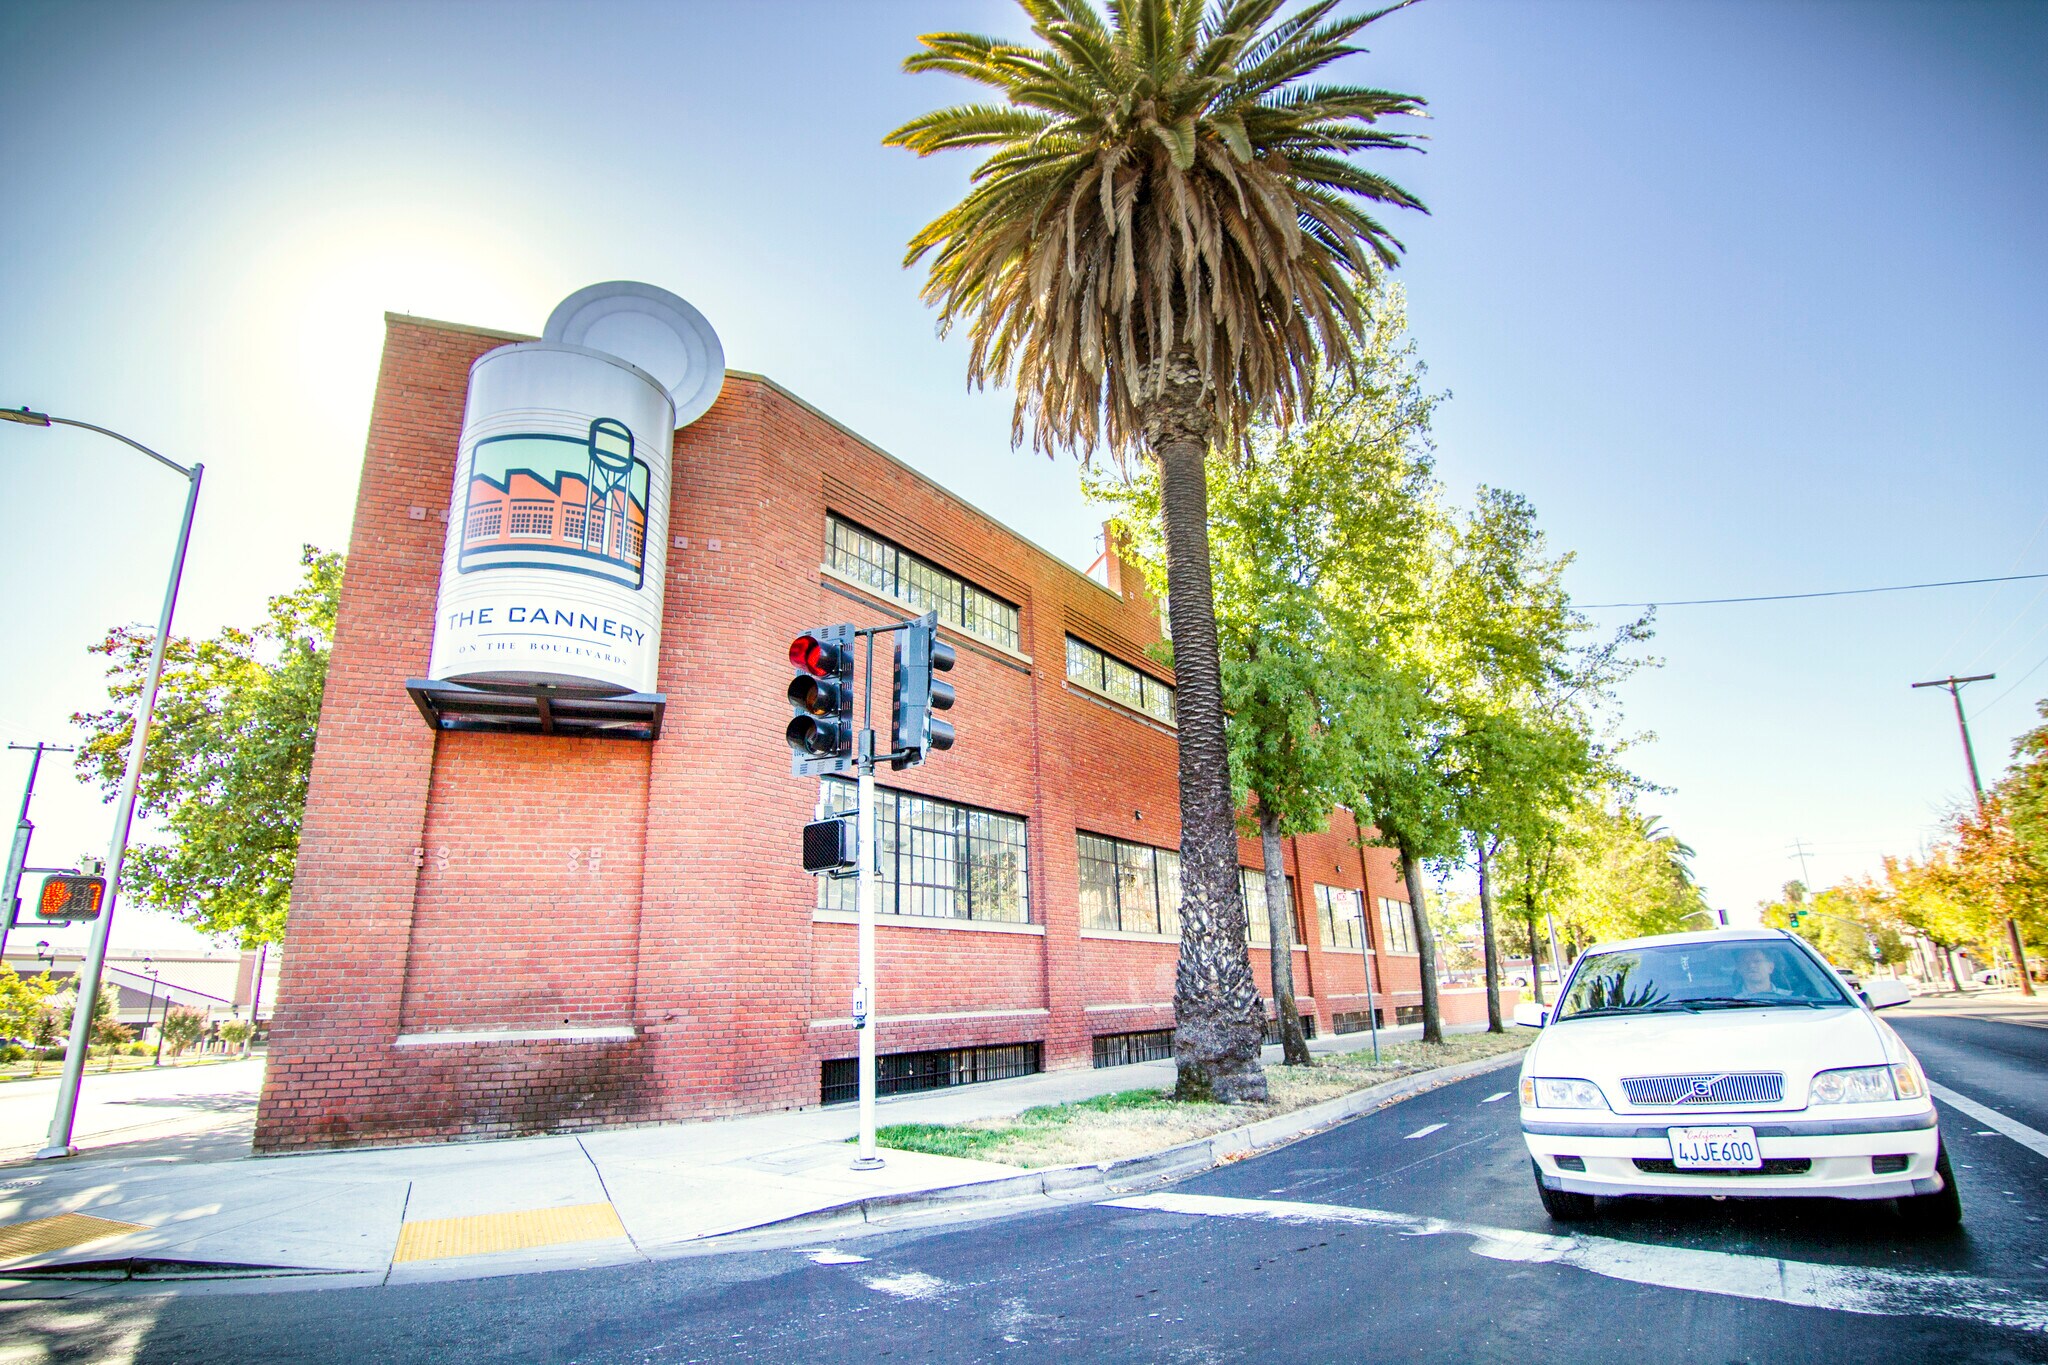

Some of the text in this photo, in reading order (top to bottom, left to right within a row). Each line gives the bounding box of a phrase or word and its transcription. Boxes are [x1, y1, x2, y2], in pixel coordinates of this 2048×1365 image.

[449, 607, 645, 646] THE CANNERY
[458, 642, 628, 665] ON THE BOULEVARDS
[1686, 1131, 1736, 1141] California
[1679, 1142, 1753, 1161] 4JJE600
